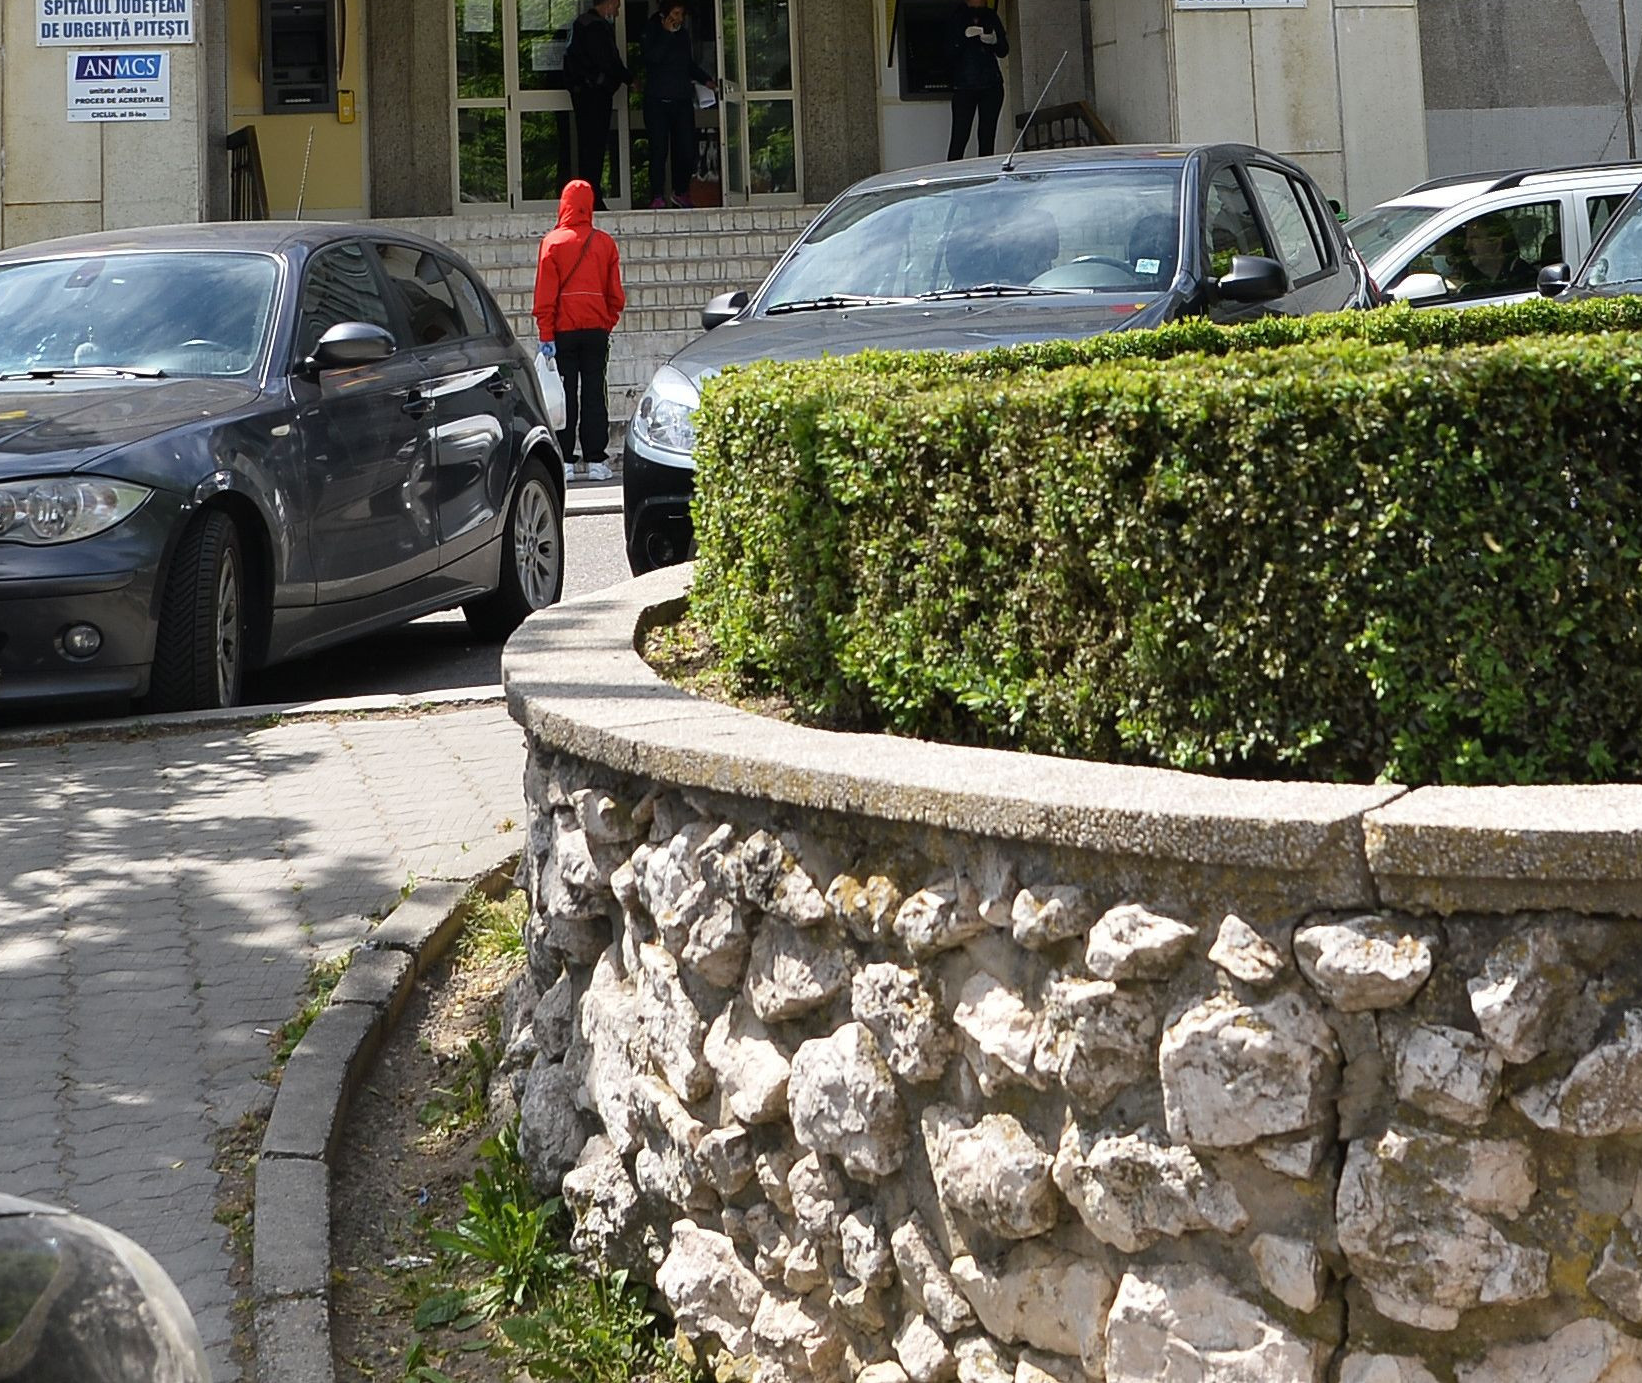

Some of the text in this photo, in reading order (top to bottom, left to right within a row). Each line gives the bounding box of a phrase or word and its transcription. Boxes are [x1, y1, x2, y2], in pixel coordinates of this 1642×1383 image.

[44, 0, 112, 16] SPITALUL
[41, 22, 60, 39] DE
[83, 58, 156, 77] ANMCS
[89, 87, 116, 95] unitate
[118, 96, 165, 104] ACREDITARE
